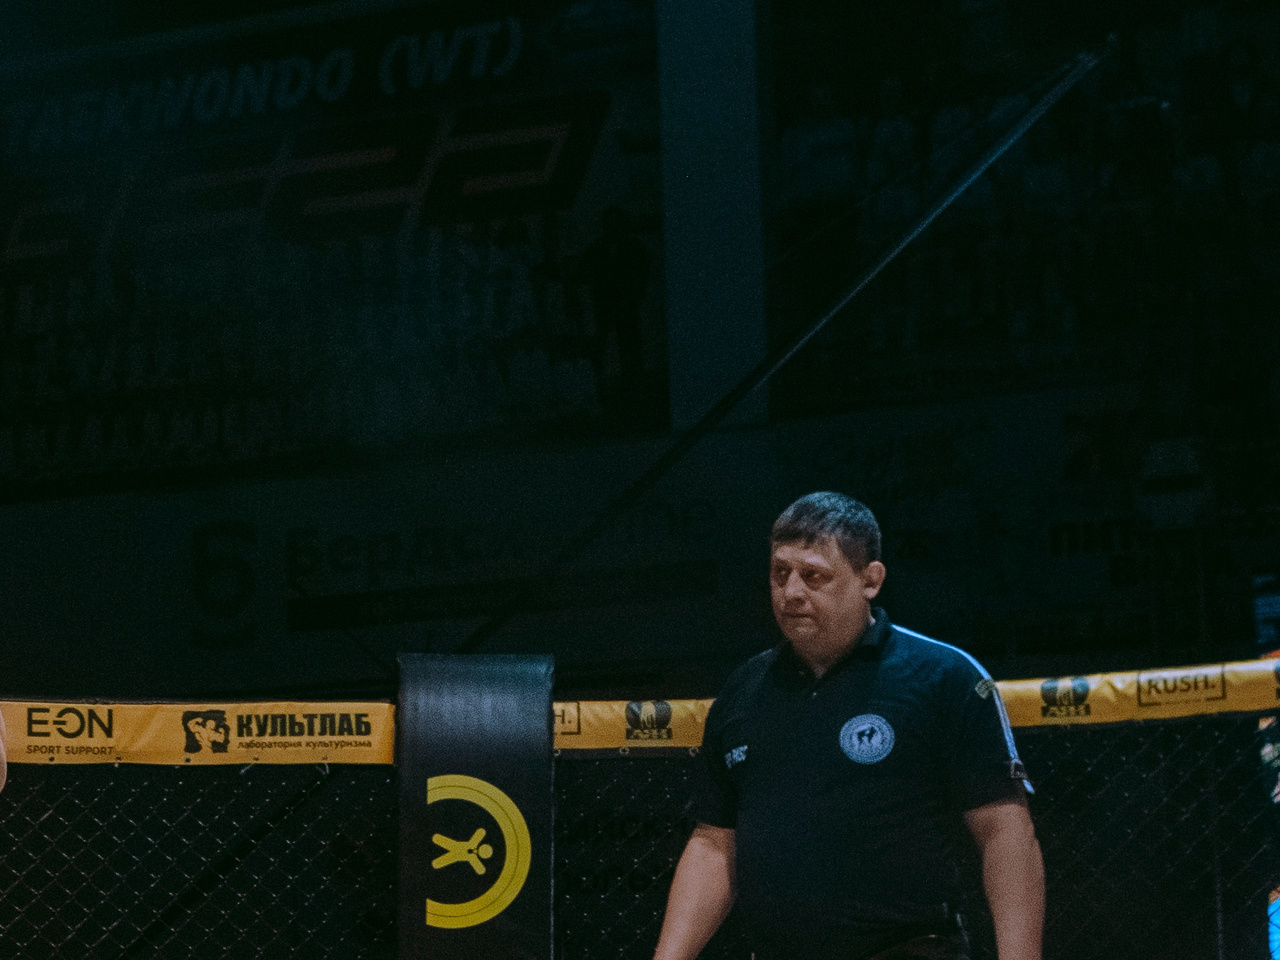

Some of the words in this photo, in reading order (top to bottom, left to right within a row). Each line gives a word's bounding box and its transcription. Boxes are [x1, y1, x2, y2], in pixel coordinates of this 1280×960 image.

[236, 713, 372, 738] КУЛЬТЛАБ
[26, 745, 62, 755] SPORT
[65, 746, 113, 755] SUPPORT
[237, 739, 302, 750] лаборатория
